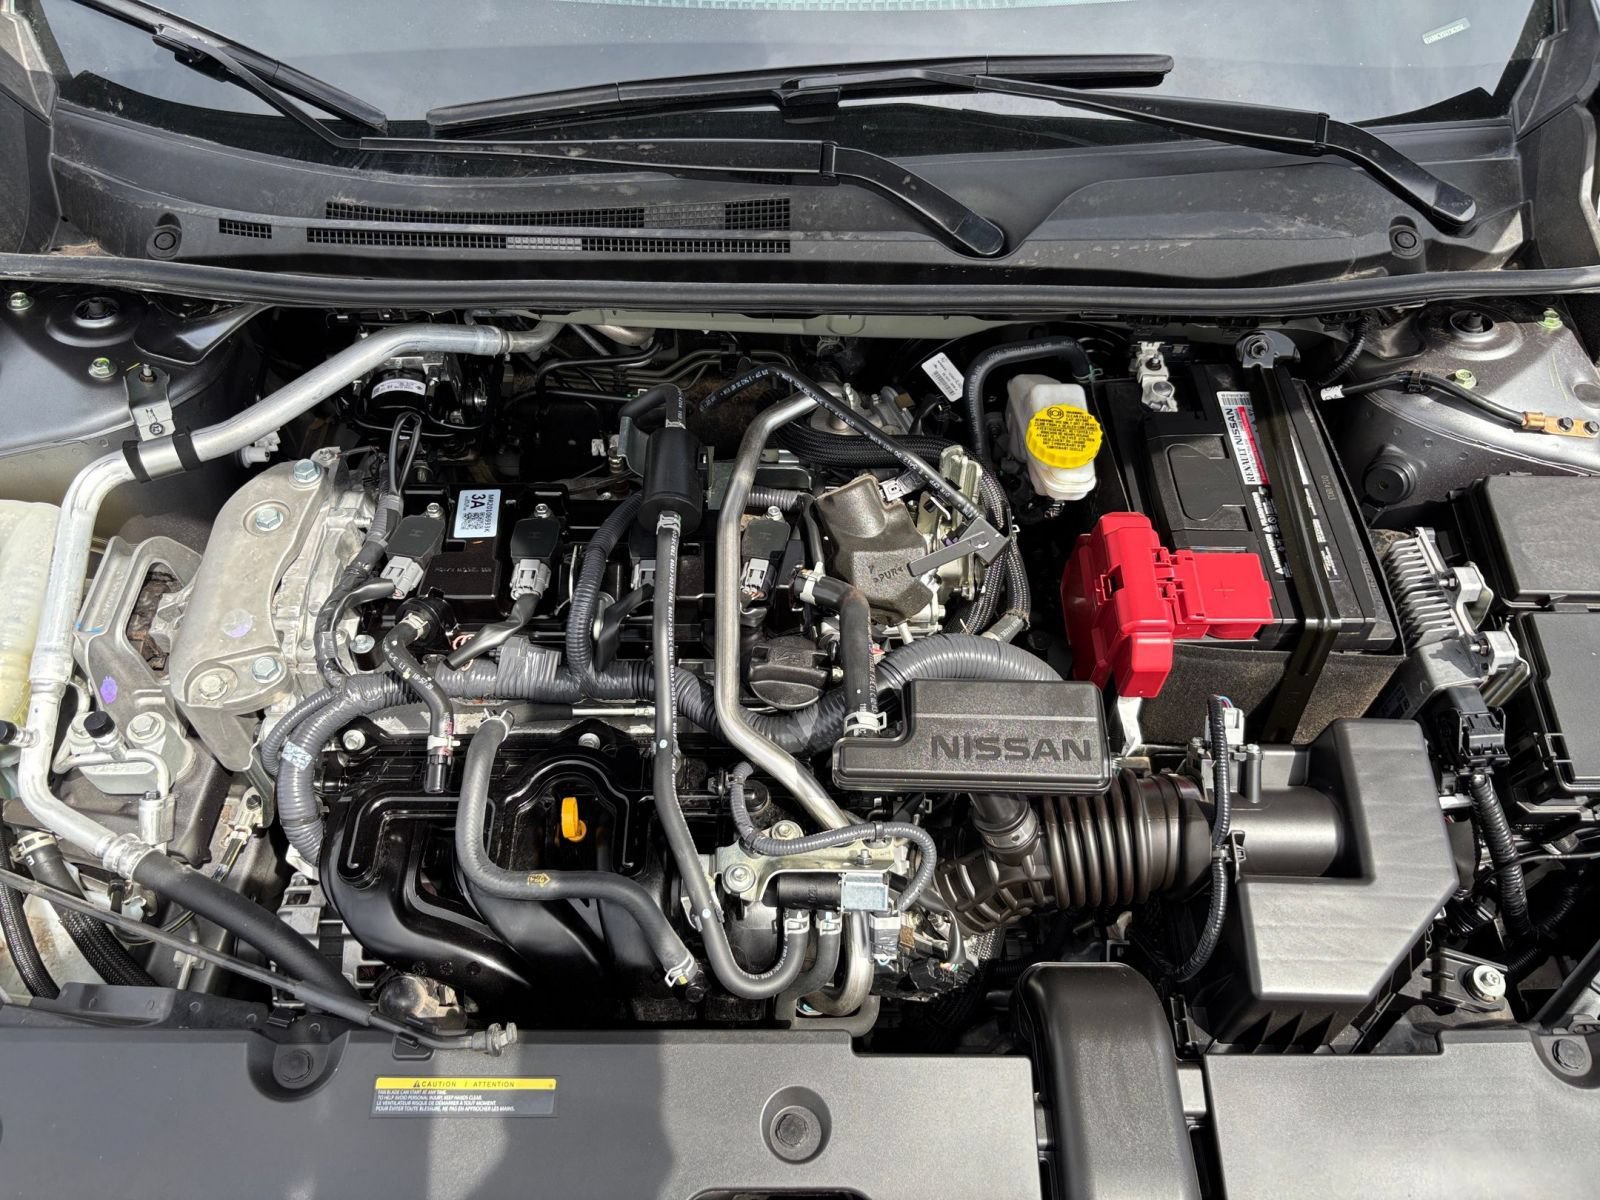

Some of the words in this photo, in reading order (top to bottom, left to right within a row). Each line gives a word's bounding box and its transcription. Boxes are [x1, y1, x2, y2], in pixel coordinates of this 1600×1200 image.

[1225, 407, 1243, 446] NISSAN
[1236, 446, 1256, 483] RENAULT
[470, 494, 486, 510] 3A
[930, 734, 1092, 762] NISSAN
[421, 1080, 457, 1088] CAUTION
[472, 1080, 515, 1088] ATTENTION
